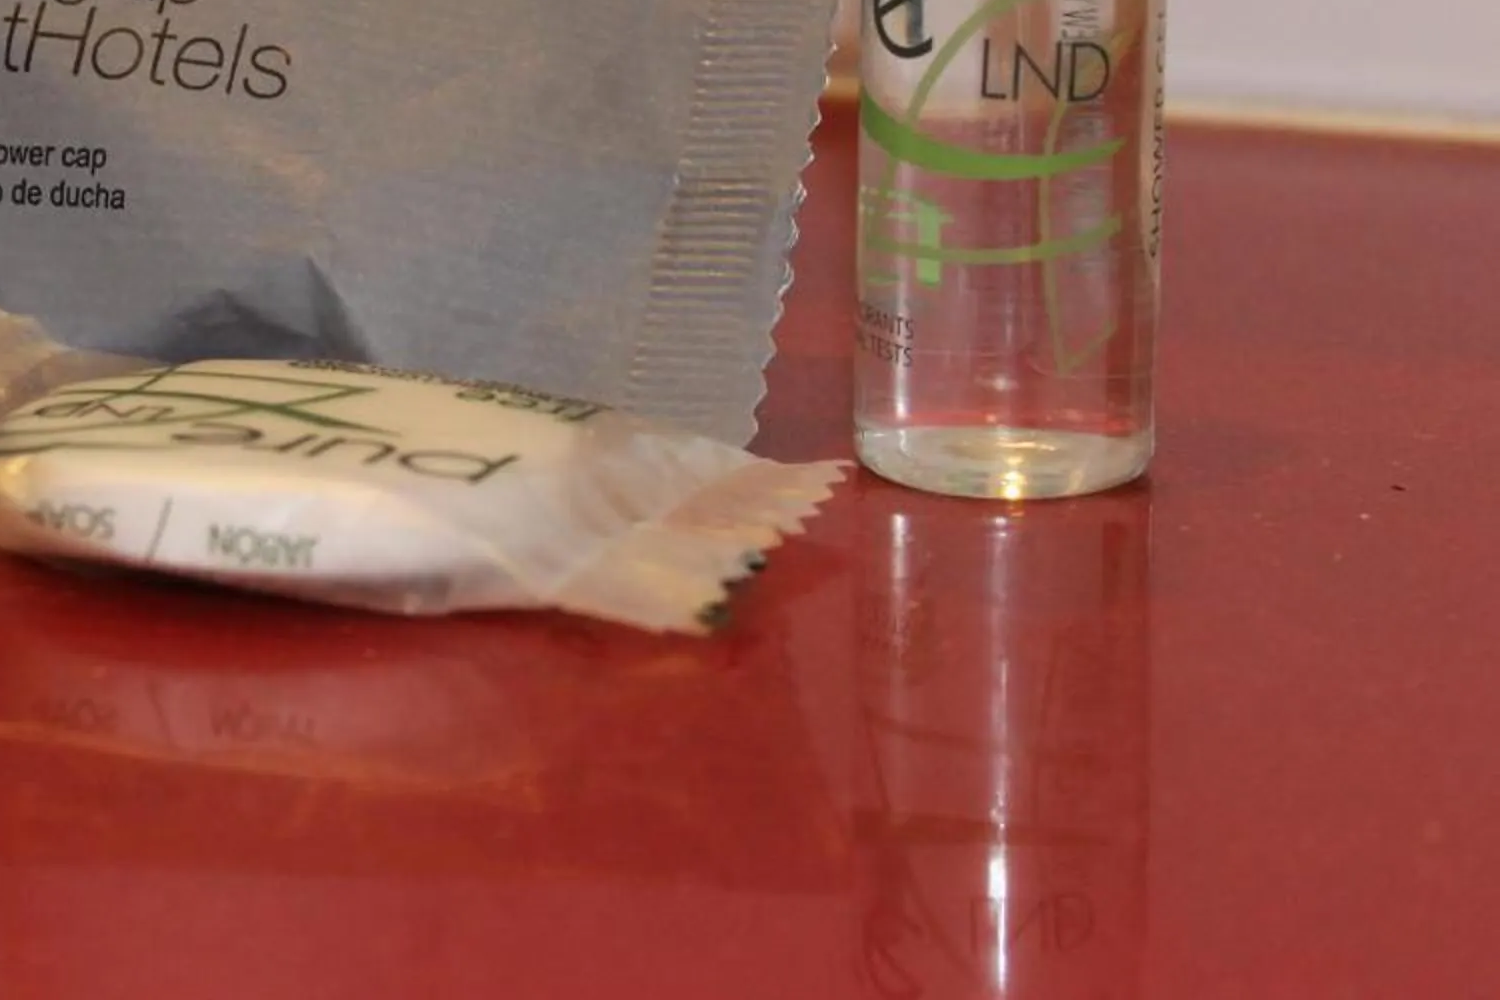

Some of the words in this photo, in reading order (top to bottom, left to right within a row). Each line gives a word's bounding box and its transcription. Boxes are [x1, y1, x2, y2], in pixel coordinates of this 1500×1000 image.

[980, 37, 1111, 103] LND
[61, 146, 107, 177] cap
[11, 178, 43, 206] de
[50, 179, 126, 210] ducha
[171, 420, 520, 487] pure
